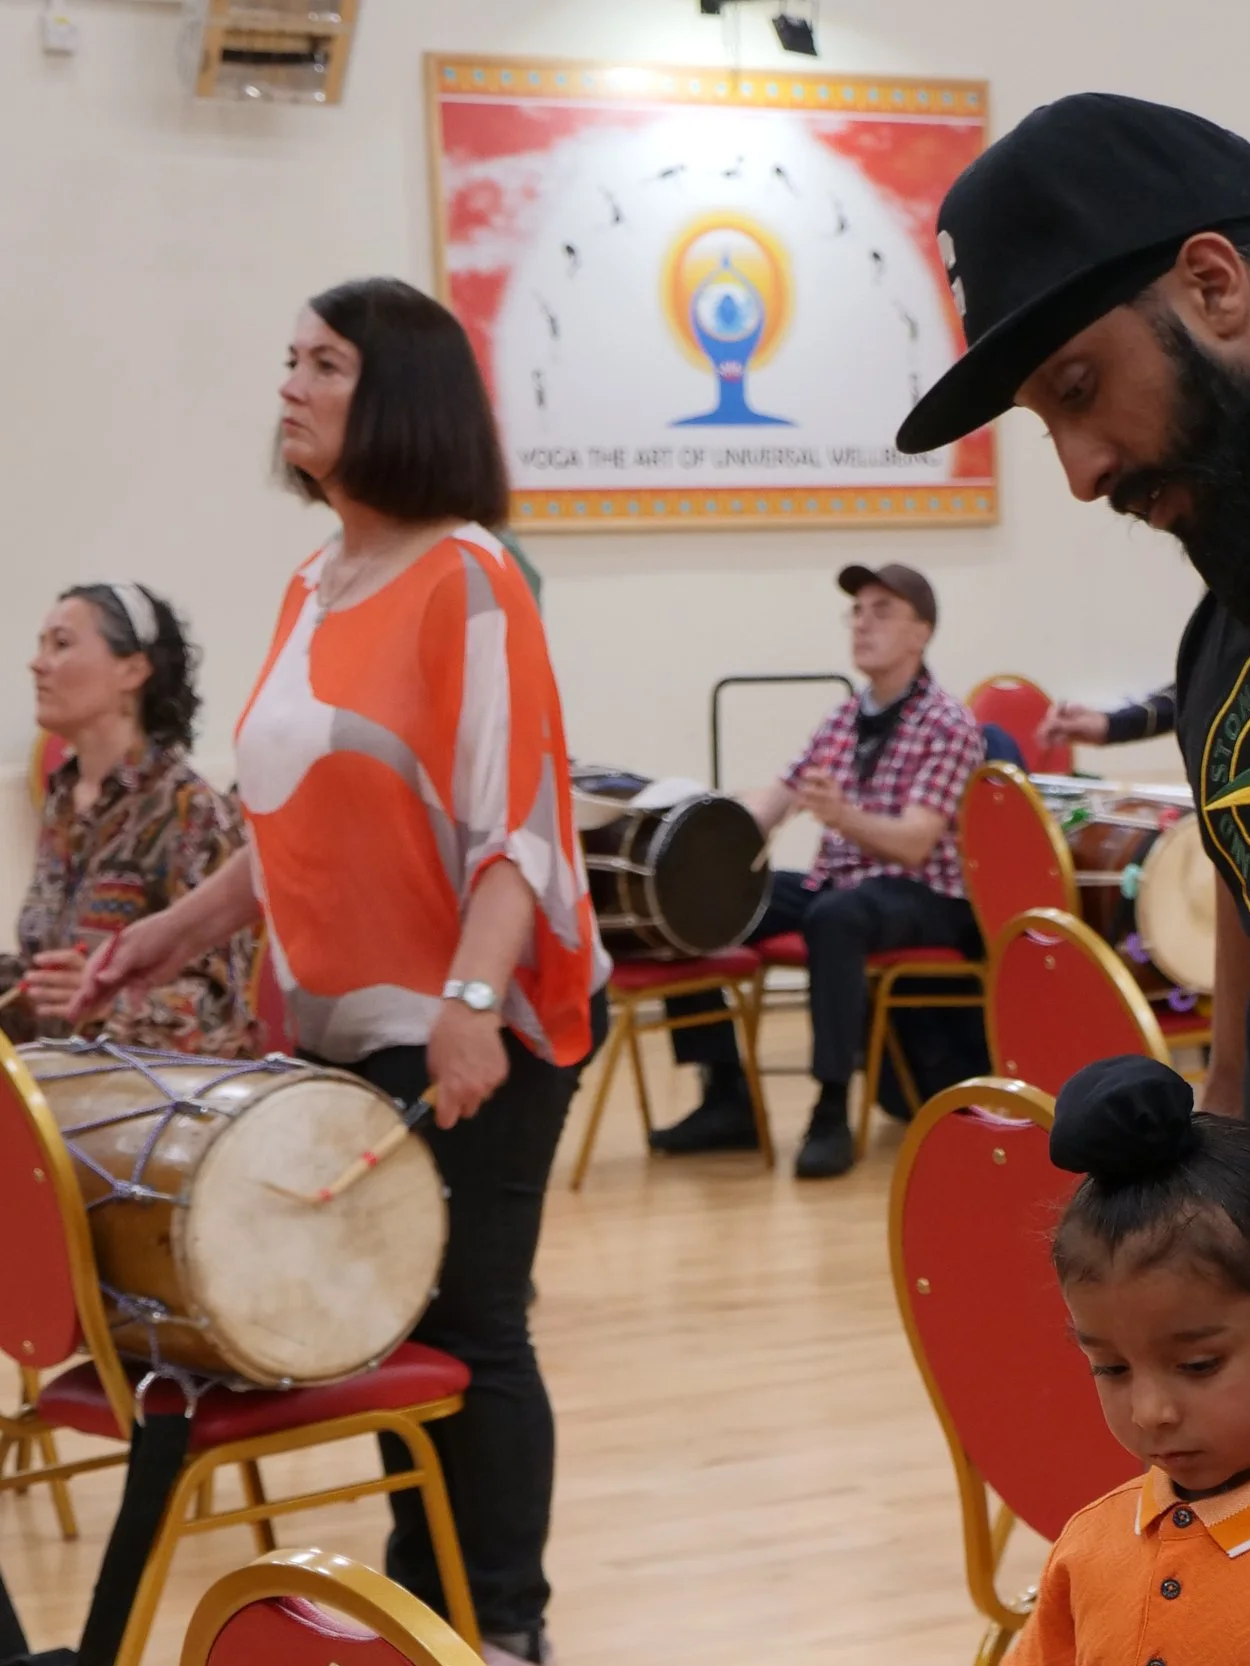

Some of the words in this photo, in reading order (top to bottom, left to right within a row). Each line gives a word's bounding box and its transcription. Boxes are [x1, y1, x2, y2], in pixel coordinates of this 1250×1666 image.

[519, 448, 581, 469] YOGA
[588, 448, 624, 468] THE
[634, 448, 672, 468] ART
[677, 448, 704, 469] OF
[712, 449, 821, 469] UNIVERSAL
